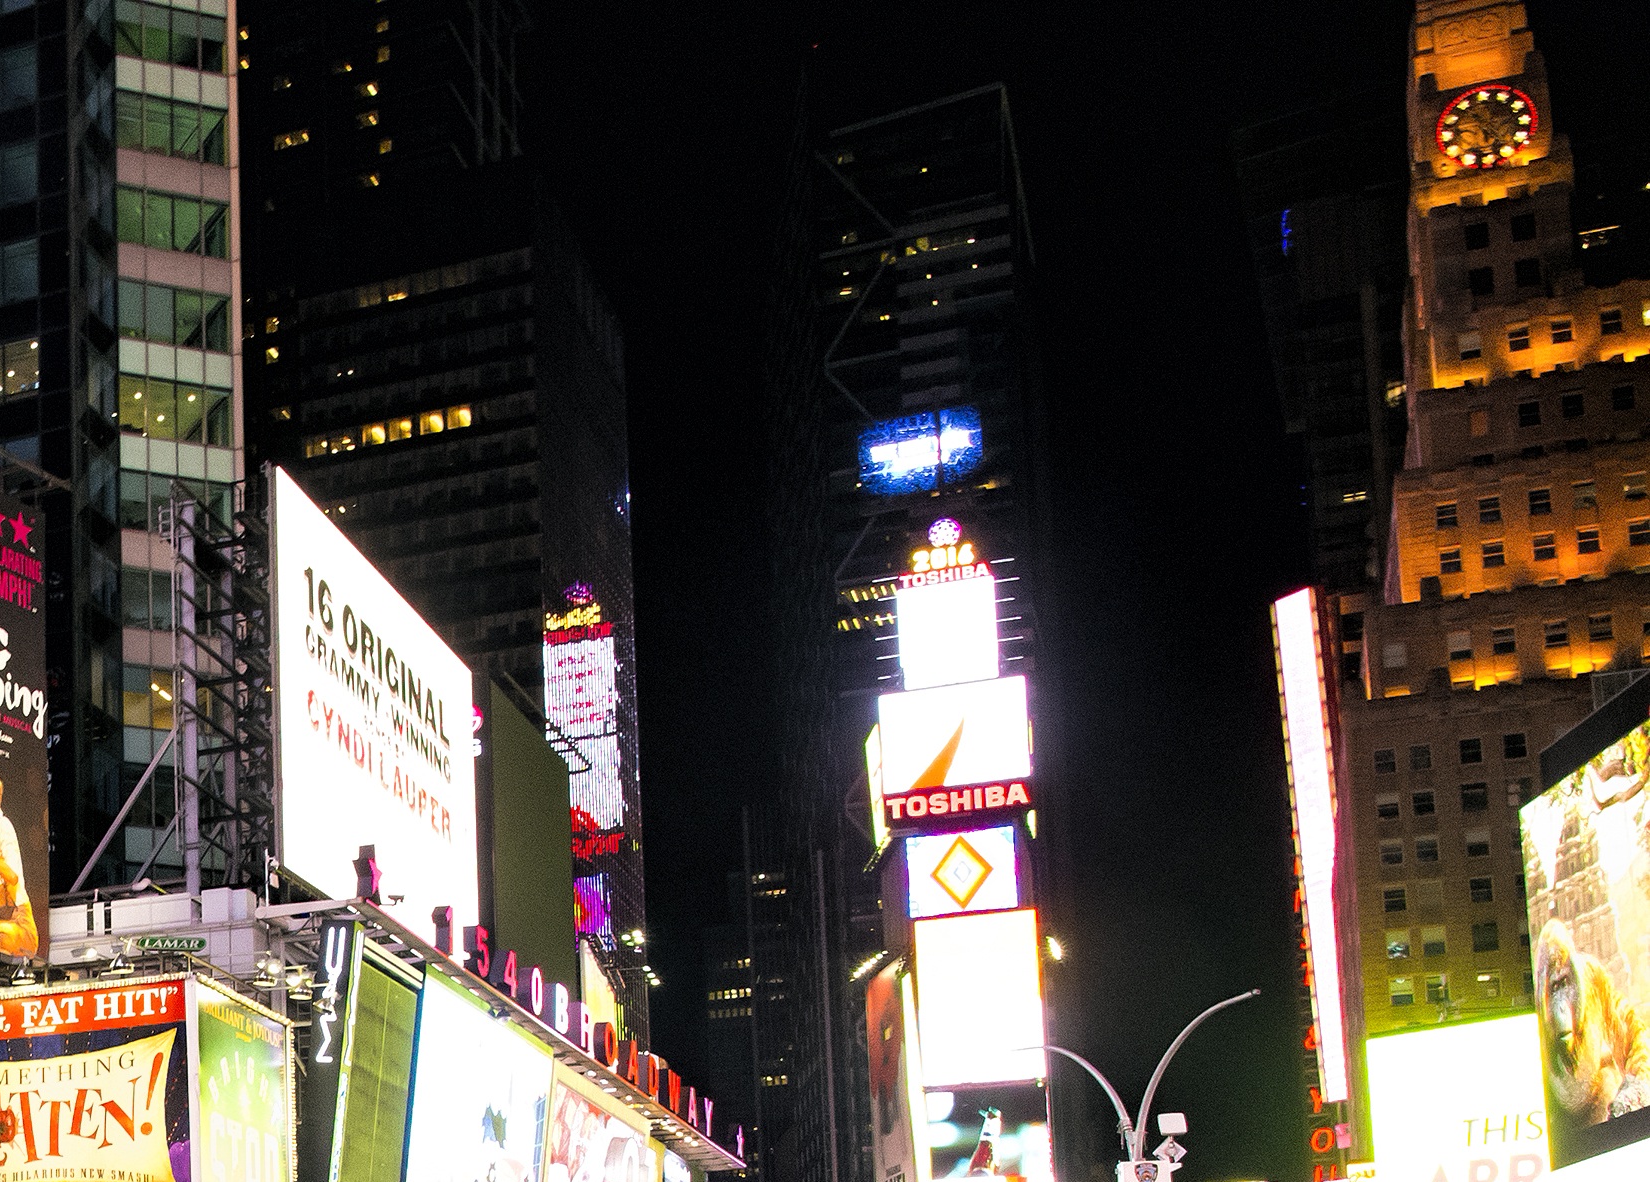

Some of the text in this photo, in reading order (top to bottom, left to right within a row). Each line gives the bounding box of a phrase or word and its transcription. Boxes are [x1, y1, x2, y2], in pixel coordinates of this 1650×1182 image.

[899, 562, 990, 590] TOSHIBA
[303, 566, 334, 637] 16
[342, 604, 451, 752] ORIGINAL
[307, 689, 373, 777] CYNDI
[379, 751, 453, 845] LAUPER
[887, 783, 1030, 820] TOSHIBA
[145, 938, 201, 949] LAMAR
[21, 995, 84, 1029] FAT
[554, 982, 714, 1137] BROADWAY
[1463, 1110, 1545, 1147] THIS
[12, 1168, 76, 1182] HILARIOUS
[80, 1168, 106, 1180] NEW
